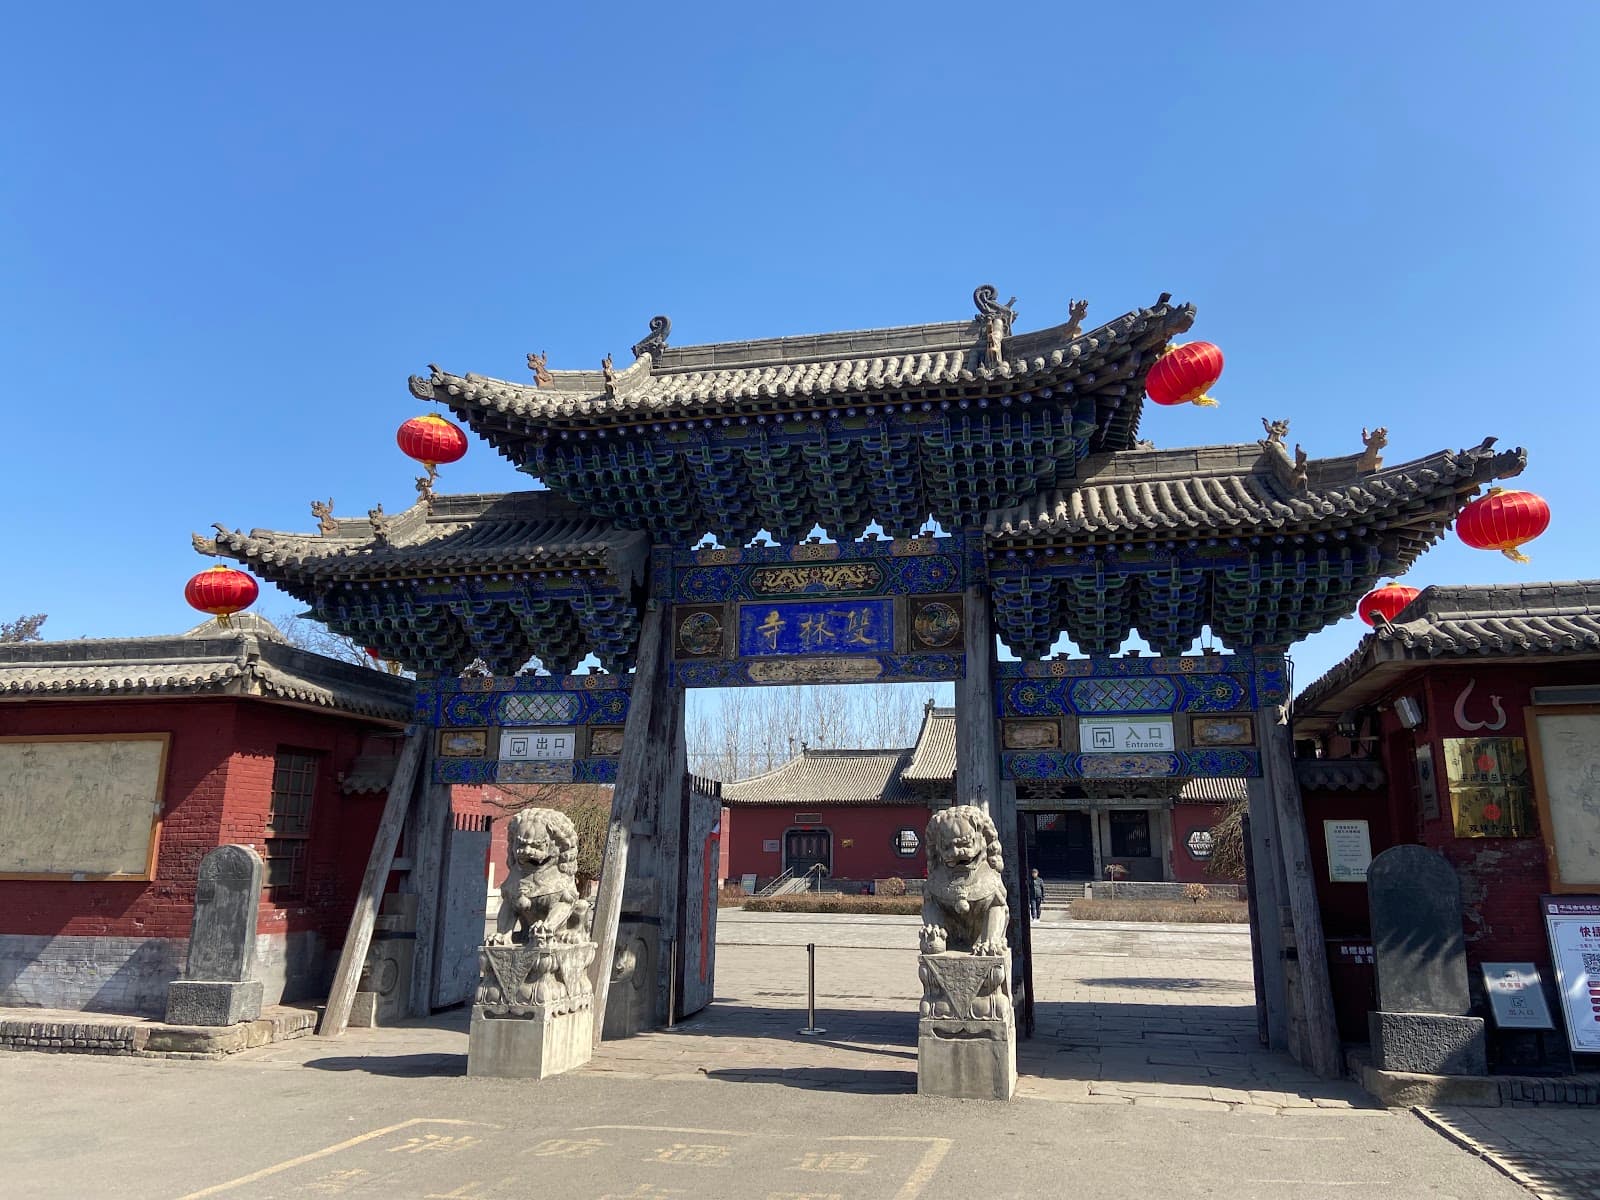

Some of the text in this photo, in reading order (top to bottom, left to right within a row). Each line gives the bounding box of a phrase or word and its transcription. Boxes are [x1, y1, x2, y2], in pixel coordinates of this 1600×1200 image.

[1126, 726, 1162, 740] 入口
[536, 737, 565, 750] 出口
[1125, 740, 1164, 749] Entrance
[384, 1133, 878, 1173] 消防通道
